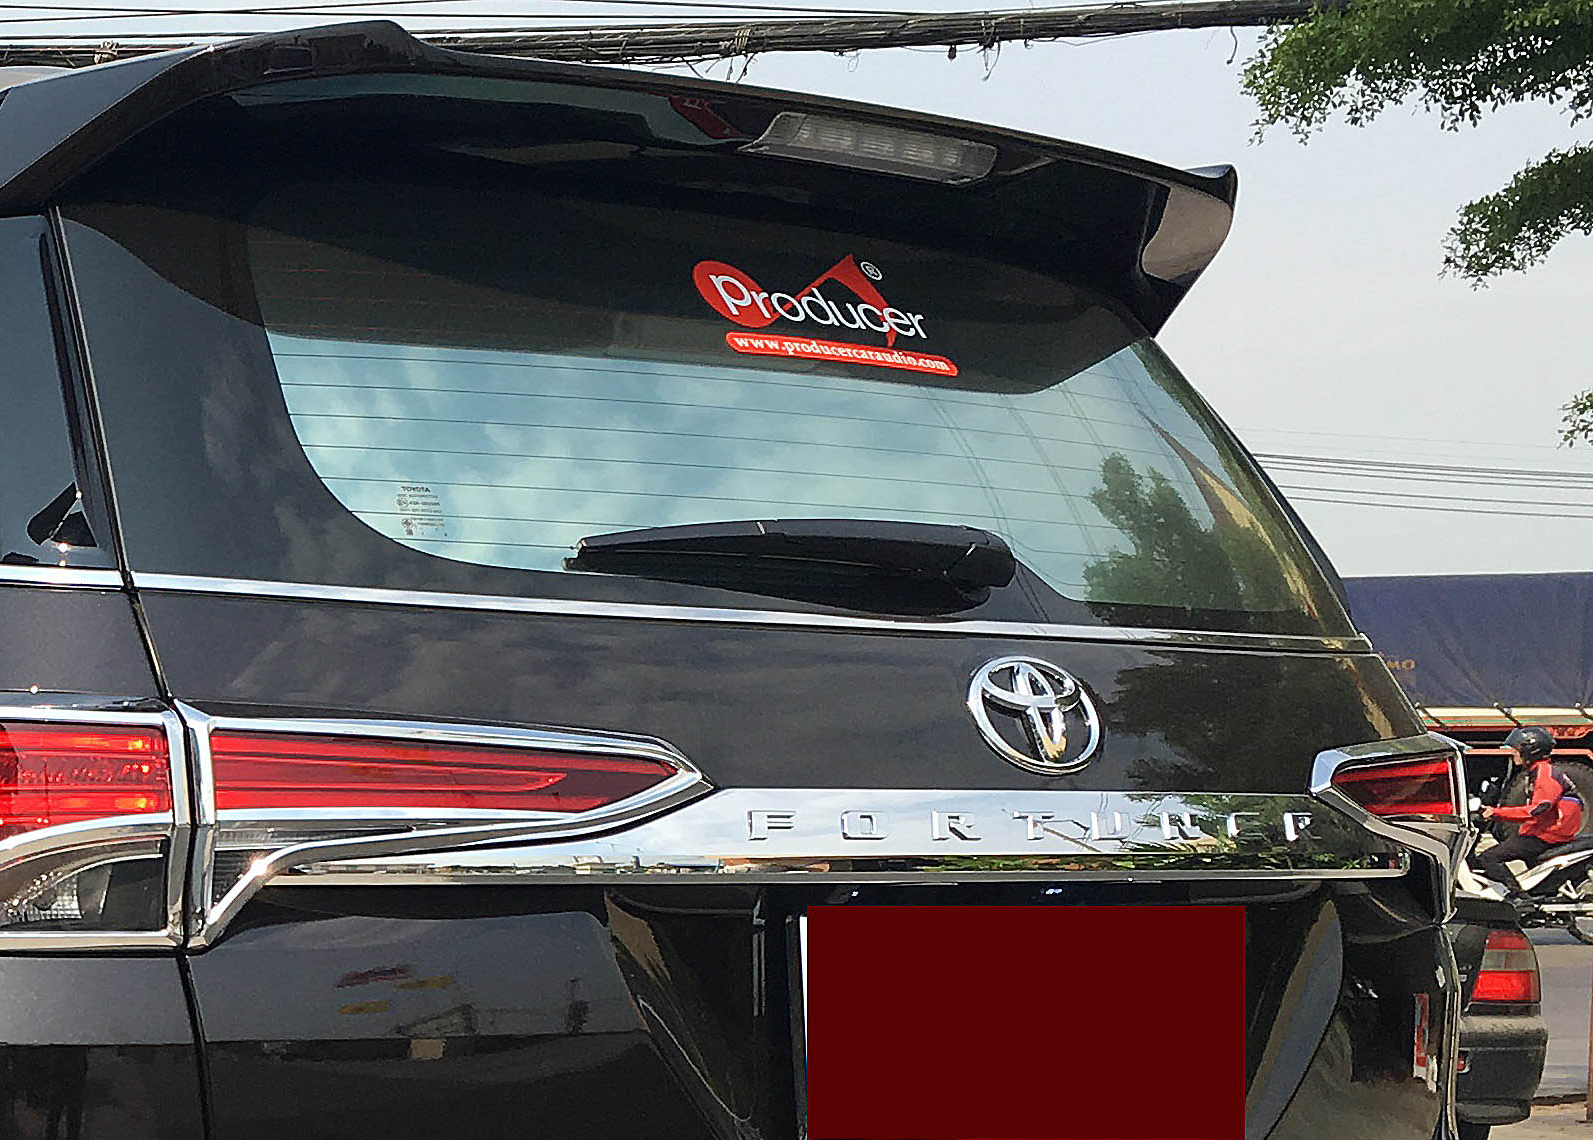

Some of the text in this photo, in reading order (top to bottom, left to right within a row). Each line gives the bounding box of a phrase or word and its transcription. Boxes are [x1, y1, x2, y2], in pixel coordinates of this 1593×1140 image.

[708, 272, 929, 339] Producer
[733, 336, 950, 372] www.producercaraudio.com
[747, 809, 1322, 842] FORTUNER
